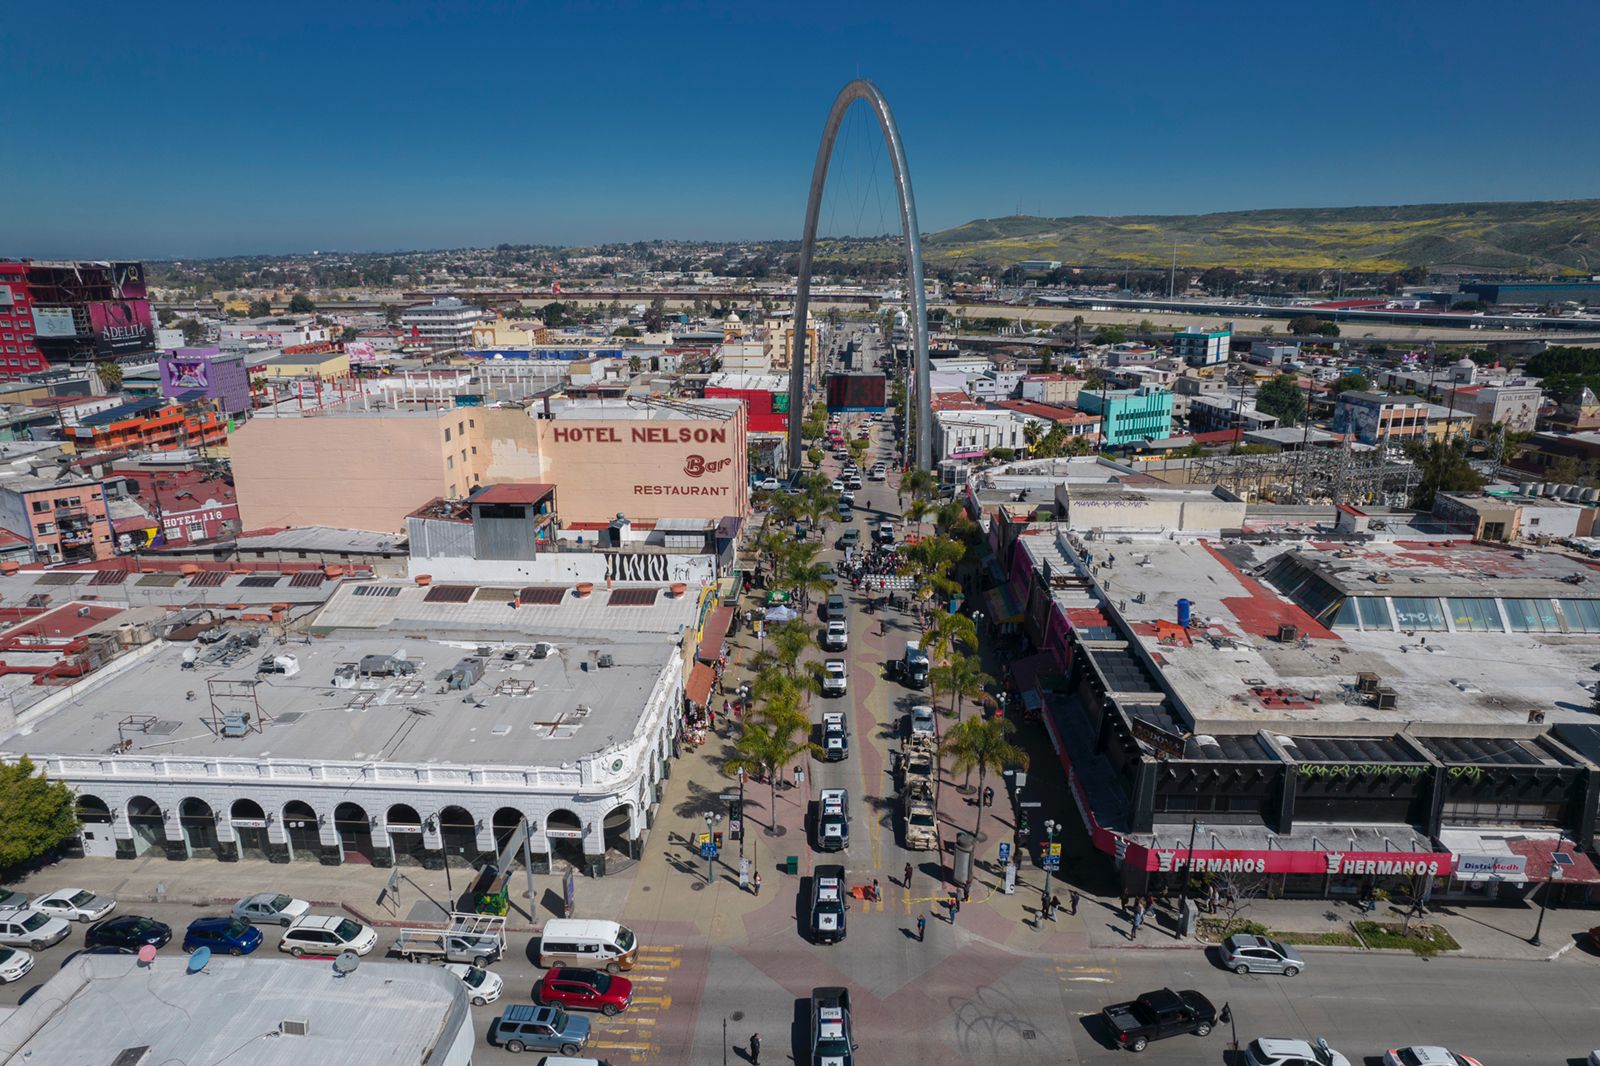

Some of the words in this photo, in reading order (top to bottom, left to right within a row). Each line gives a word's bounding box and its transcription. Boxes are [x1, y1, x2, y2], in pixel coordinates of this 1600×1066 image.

[103, 323, 147, 339] ADELITA
[554, 427, 622, 443] HOTEL
[631, 427, 726, 443] NELSON
[683, 454, 731, 478] Bar
[633, 485, 729, 497] RESTAURANT
[1174, 858, 1265, 873] HERMANOS
[1343, 860, 1439, 876] HERMANOS
